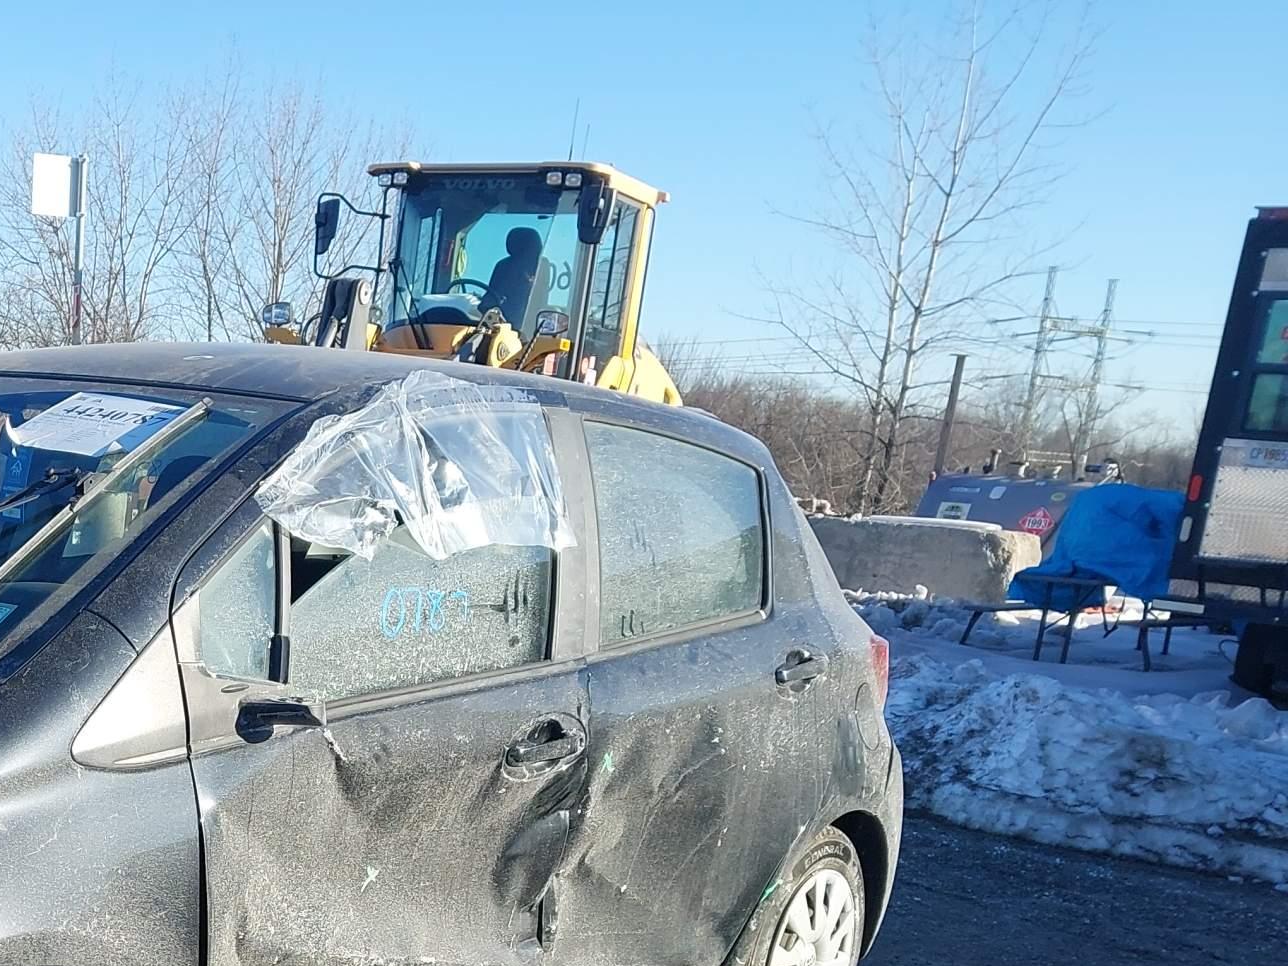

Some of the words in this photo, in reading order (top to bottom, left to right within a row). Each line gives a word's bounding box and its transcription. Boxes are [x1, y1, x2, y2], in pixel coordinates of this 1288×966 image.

[442, 178, 515, 189] VOLVO
[64, 404, 170, 426] 44240787
[1027, 517, 1048, 528] 1993
[380, 584, 472, 640] 0787
[804, 843, 846, 869] GENERAL
